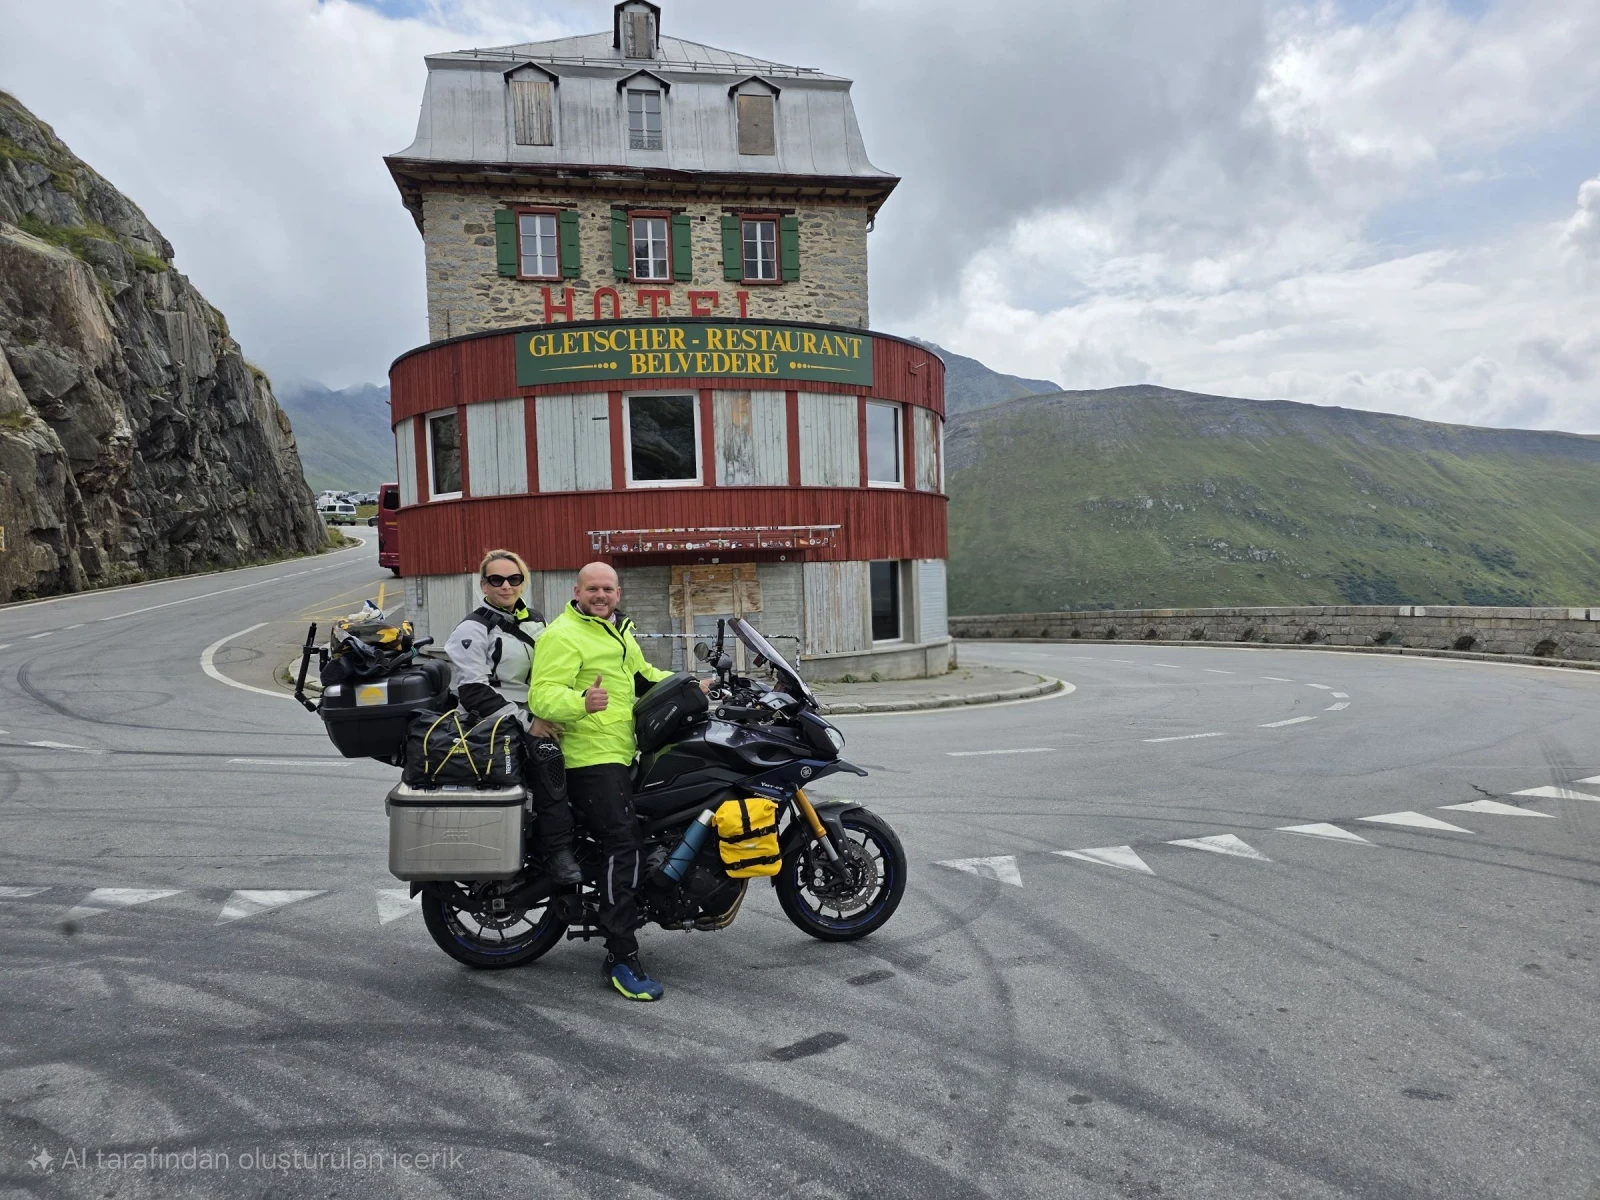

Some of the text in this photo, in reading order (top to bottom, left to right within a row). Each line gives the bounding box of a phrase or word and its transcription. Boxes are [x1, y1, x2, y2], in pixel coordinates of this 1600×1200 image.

[528, 327, 687, 358] GLETSCHER
[706, 327, 863, 360] RESTAURANT
[629, 351, 780, 375] BELVEDERE
